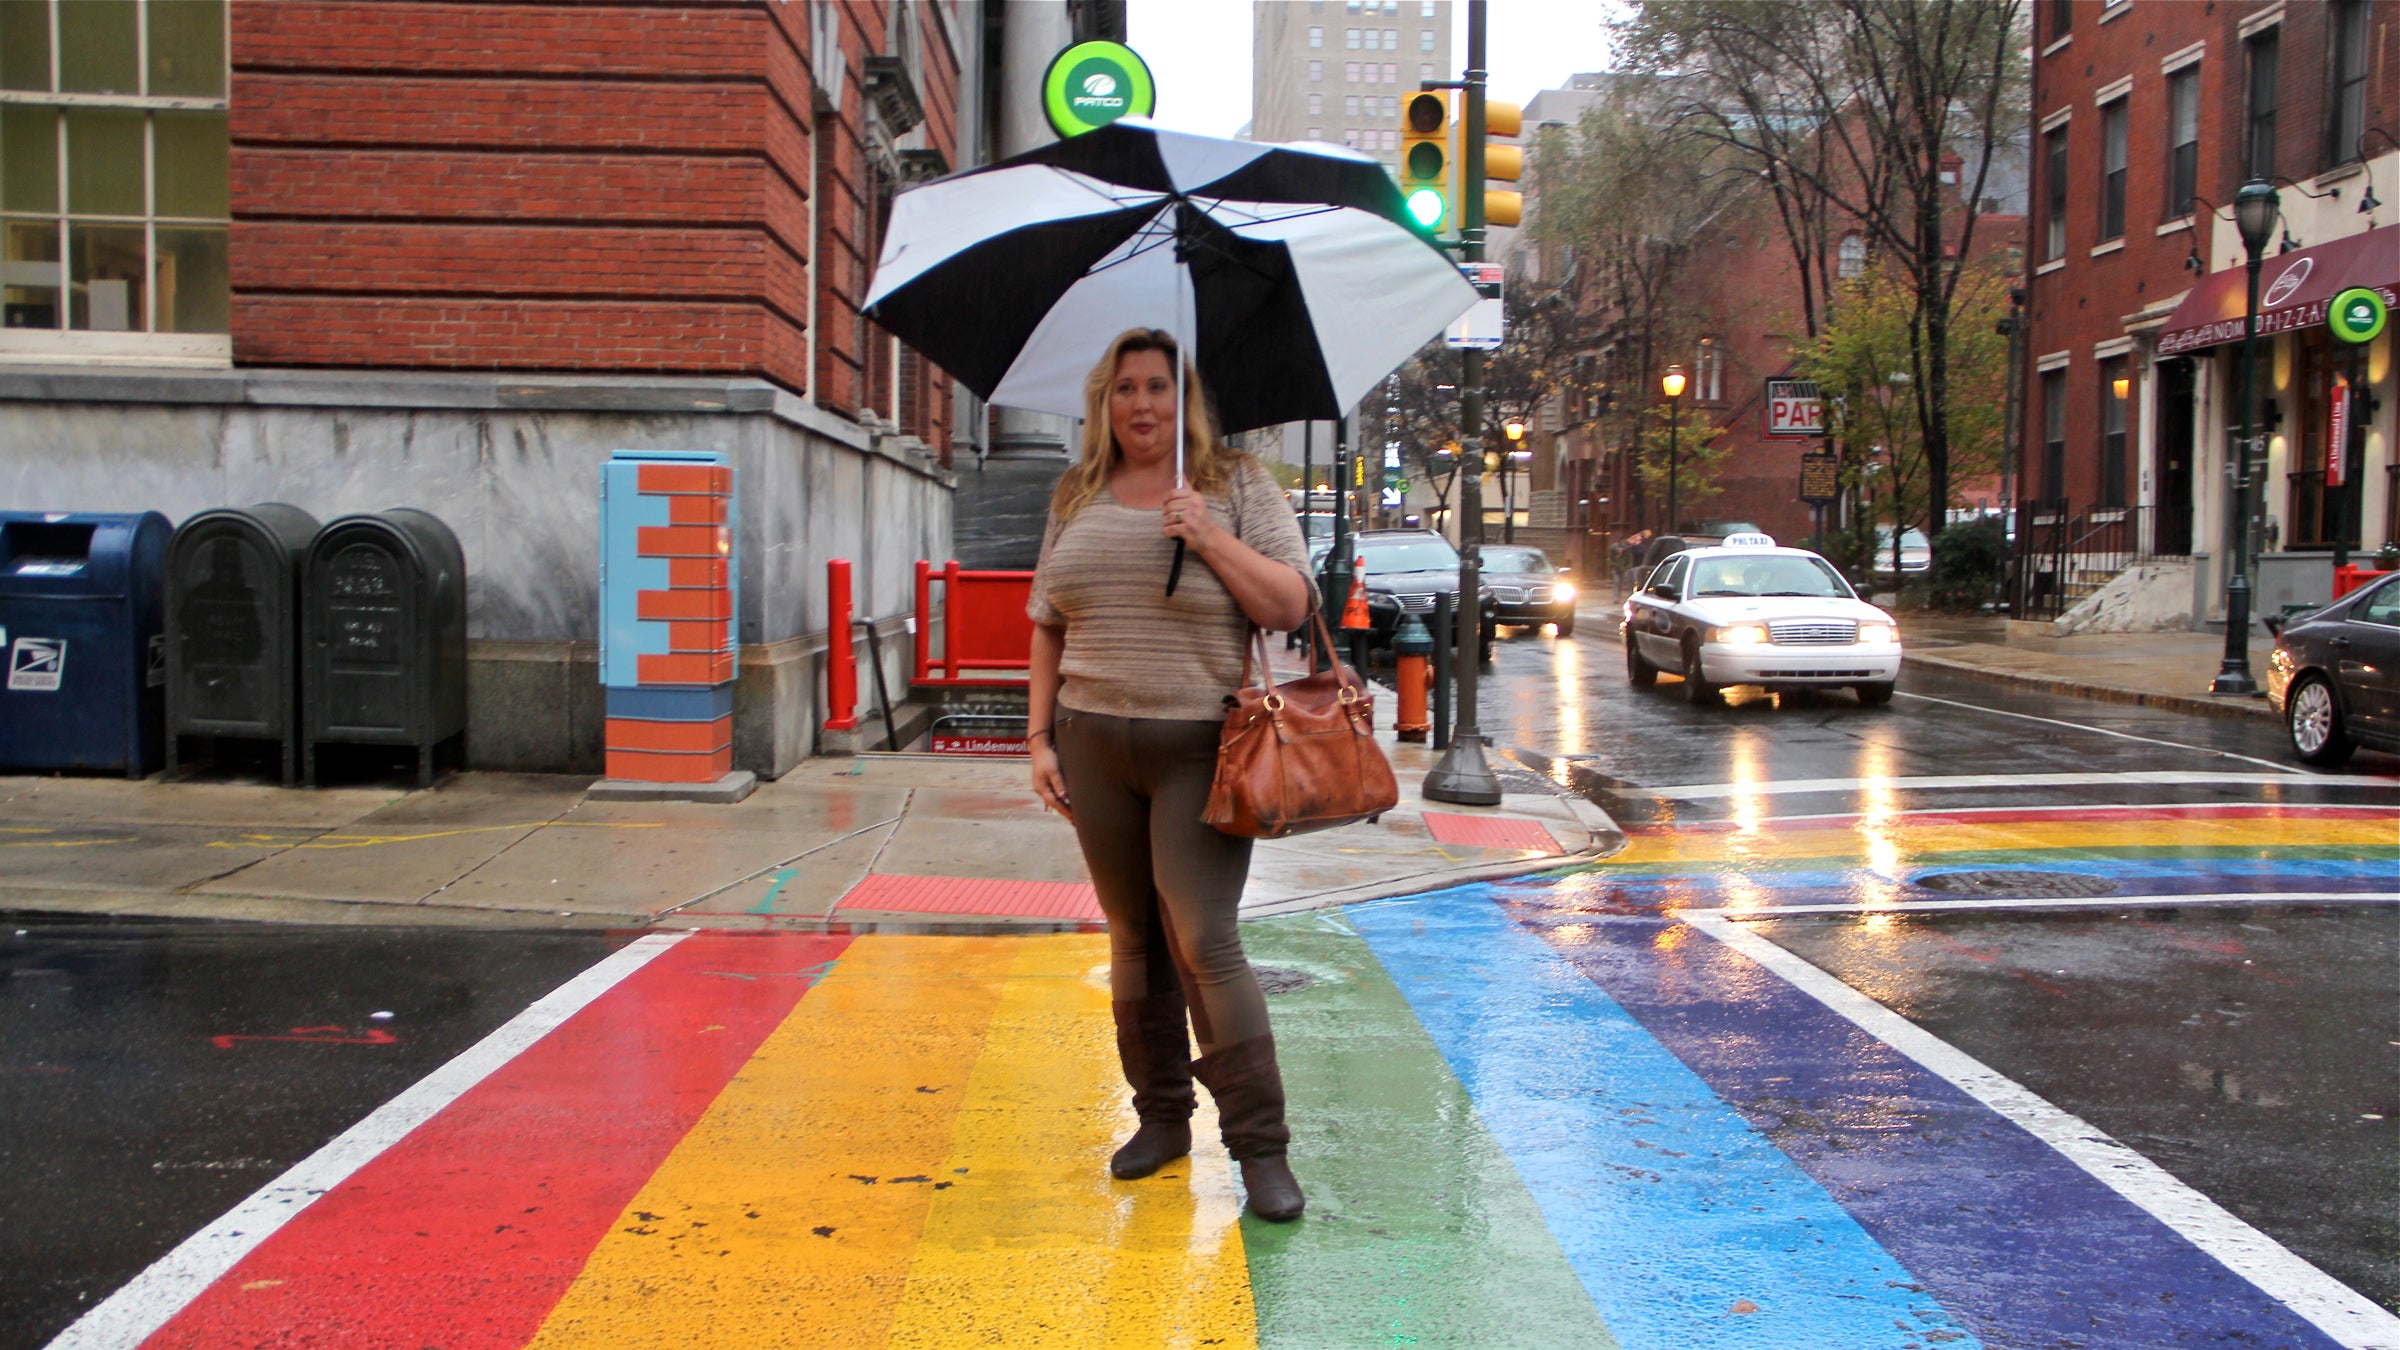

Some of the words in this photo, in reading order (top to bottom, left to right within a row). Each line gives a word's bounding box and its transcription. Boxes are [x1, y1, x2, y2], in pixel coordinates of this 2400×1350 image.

[1073, 97, 1123, 107] PATCO
[2214, 315, 2264, 340] NOMD
[1772, 401, 1826, 428] PAR
[1732, 537, 1748, 545] PHL
[1749, 537, 1768, 545] TAXI
[966, 740, 1030, 752] Lindenwol
